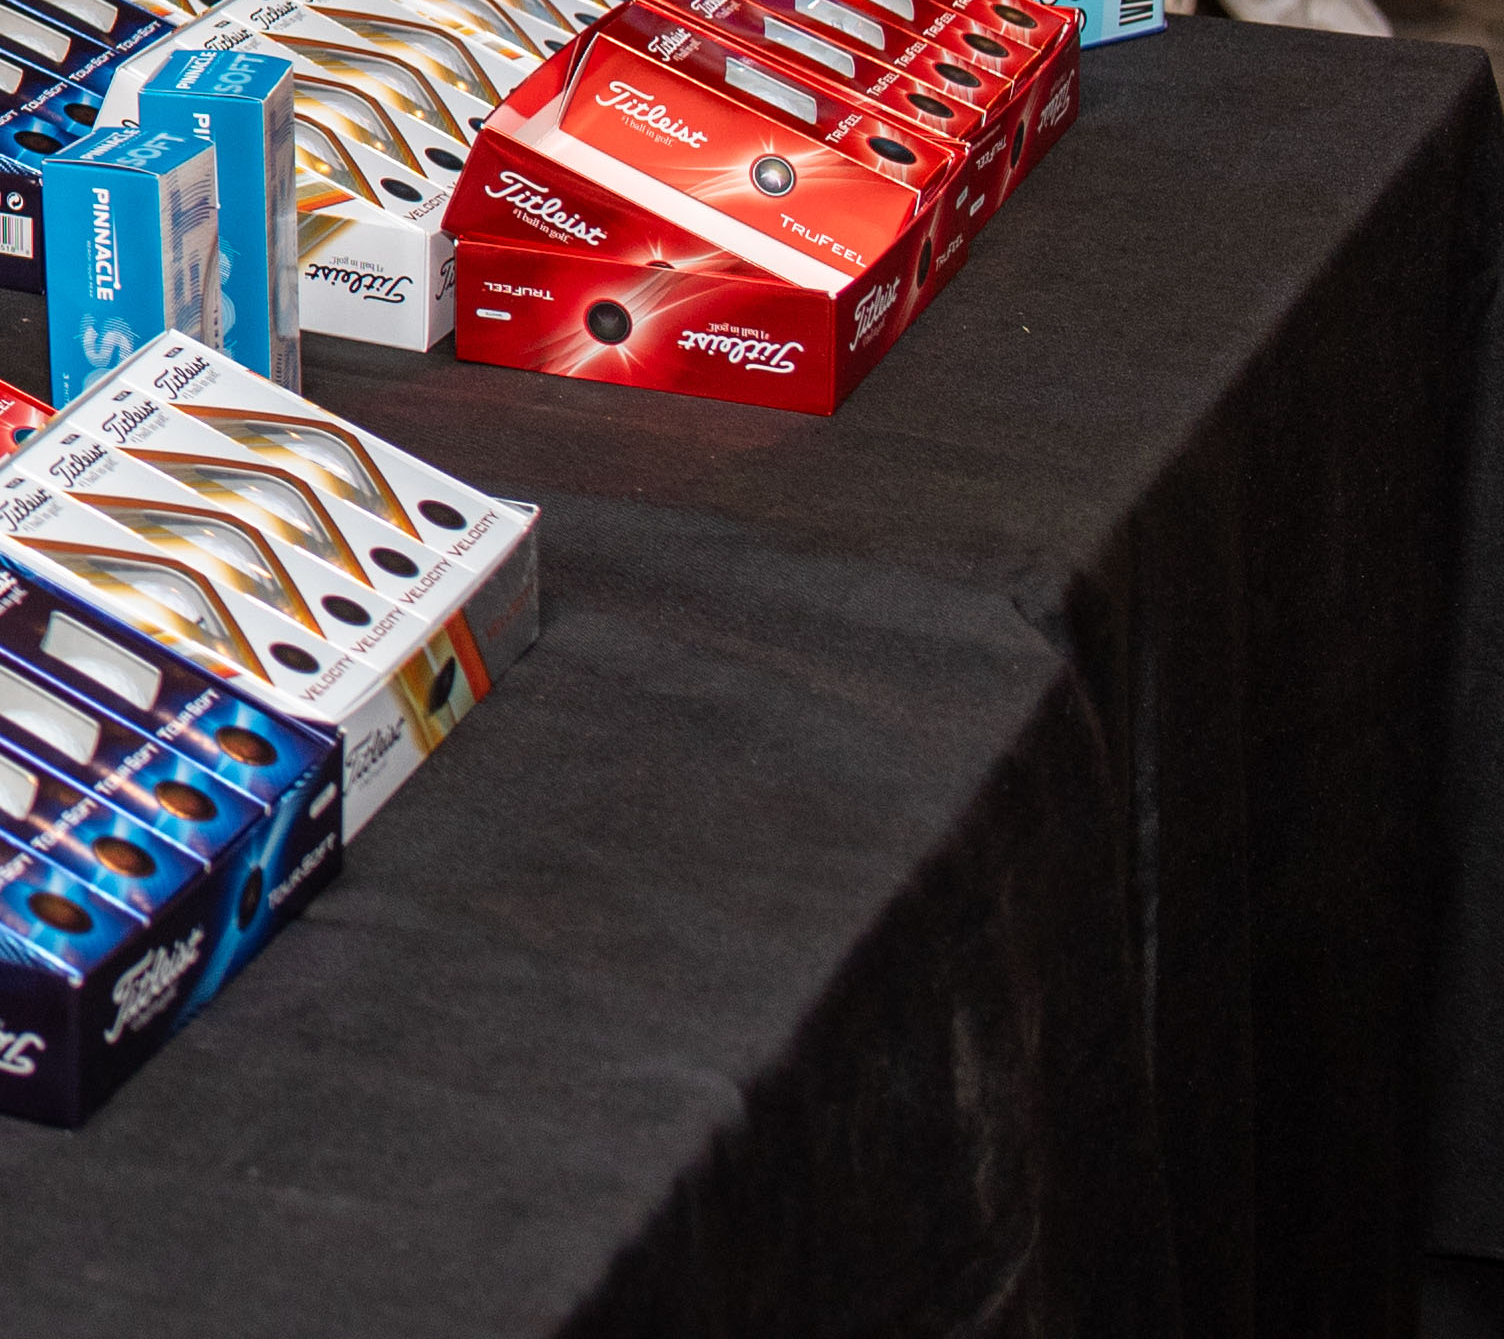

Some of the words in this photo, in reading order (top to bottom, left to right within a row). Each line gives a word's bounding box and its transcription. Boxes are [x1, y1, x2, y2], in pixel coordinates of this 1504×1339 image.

[250, 1, 298, 31] Titleist
[923, 12, 956, 38] TRUFEEL
[648, 27, 692, 62] Titleist
[894, 41, 927, 68] TRUFEEL
[175, 51, 218, 90] PINNACLE
[214, 53, 267, 95] SOFT
[867, 72, 900, 98] TRUFEEL
[594, 80, 708, 149] Titleist
[825, 113, 863, 144] TRUFEEL
[119, 132, 187, 167] SOFT
[484, 170, 607, 247] Titleist
[522, 212, 540, 228] ball
[540, 224, 549, 234] in
[92, 187, 115, 301] PINNACLE
[780, 213, 867, 269] TRUFEEL
[305, 263, 413, 303] Titleist
[483, 281, 554, 302] TRUFEEL
[730, 325, 740, 336] in
[741, 327, 759, 339] ball
[850, 276, 901, 351] Titleist
[677, 330, 804, 374] Titleist
[154, 354, 210, 400] Titleist
[102, 400, 159, 444] Titleist
[49, 443, 108, 488] Titleist
[447, 509, 501, 558] VELOCITY
[399, 557, 454, 606] VELOCITY
[350, 606, 405, 654] VELOCITY
[298, 653, 354, 703] VELOCITY
